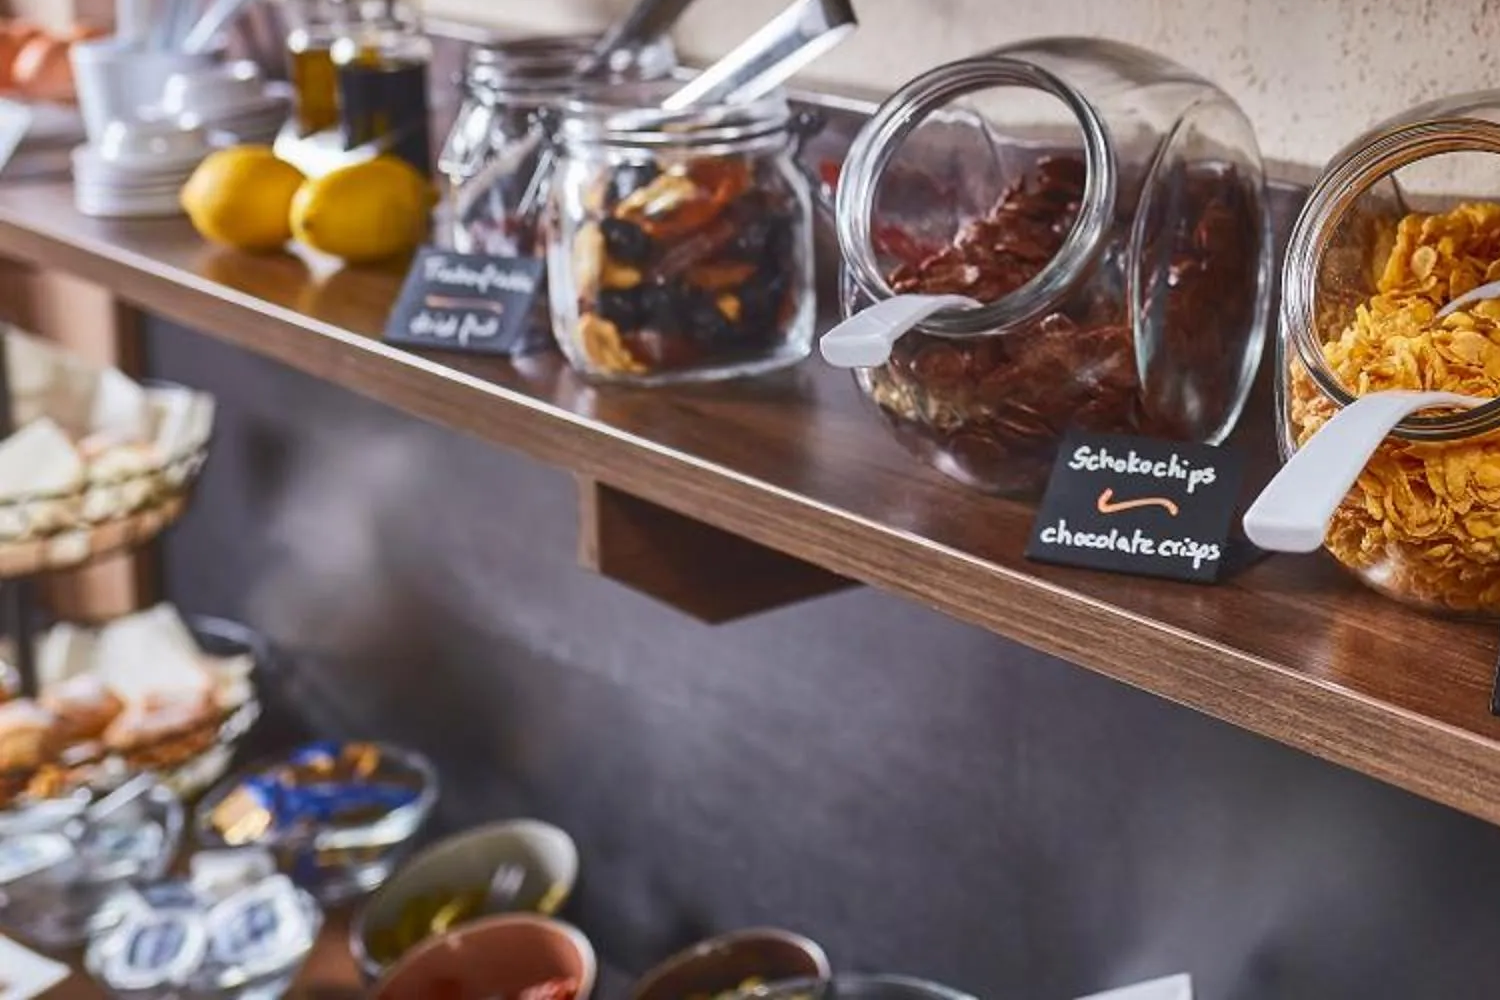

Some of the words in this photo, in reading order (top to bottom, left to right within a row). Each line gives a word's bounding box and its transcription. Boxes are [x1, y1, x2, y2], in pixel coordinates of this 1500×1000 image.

[1067, 445, 1217, 495] Schokochips
[1040, 518, 1153, 555] chocolate
[1157, 536, 1221, 570] crisps
